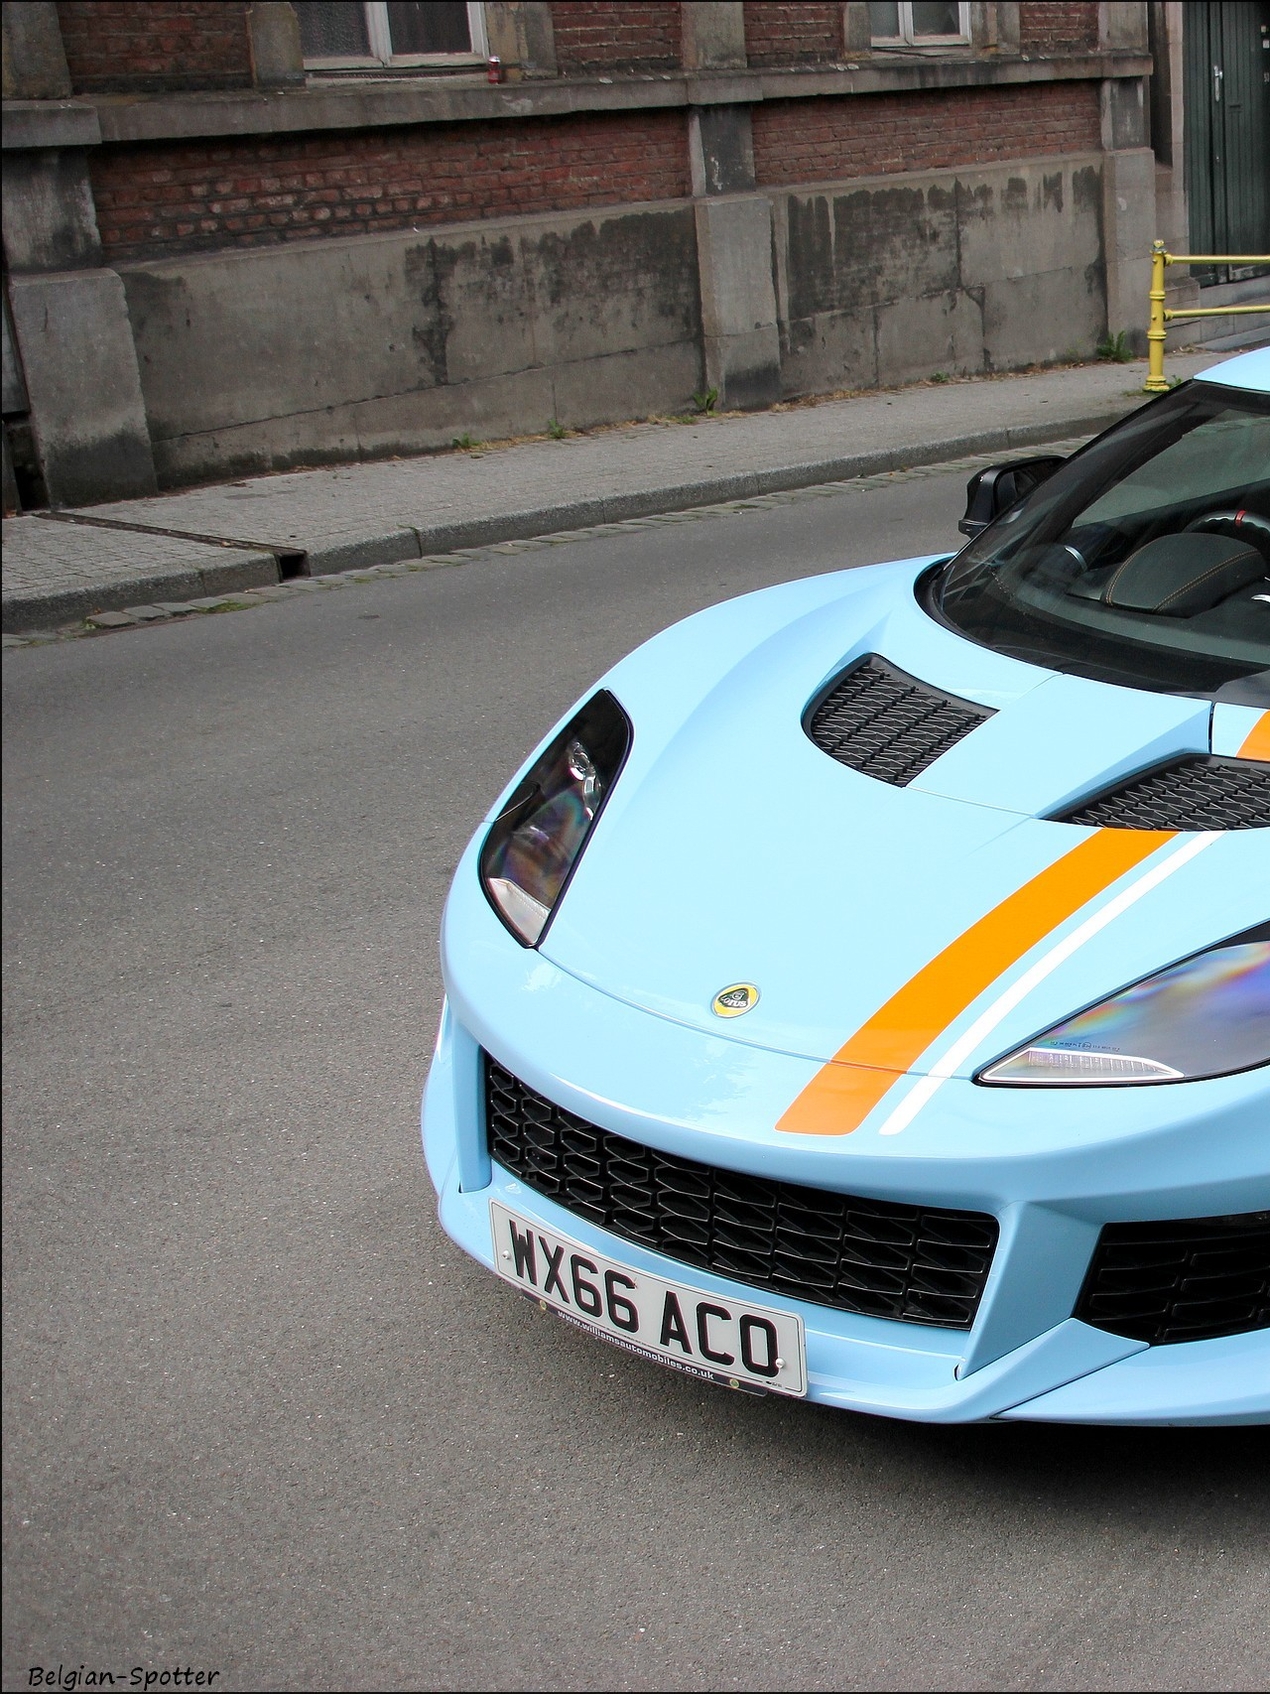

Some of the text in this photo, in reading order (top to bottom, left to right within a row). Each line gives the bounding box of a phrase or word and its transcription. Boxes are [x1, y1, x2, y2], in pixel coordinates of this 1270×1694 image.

[721, 996, 746, 1007] LOTUS
[508, 1219, 781, 1378] WX66 ACO
[557, 1310, 716, 1381] www.williamsautomobiles.co.uk
